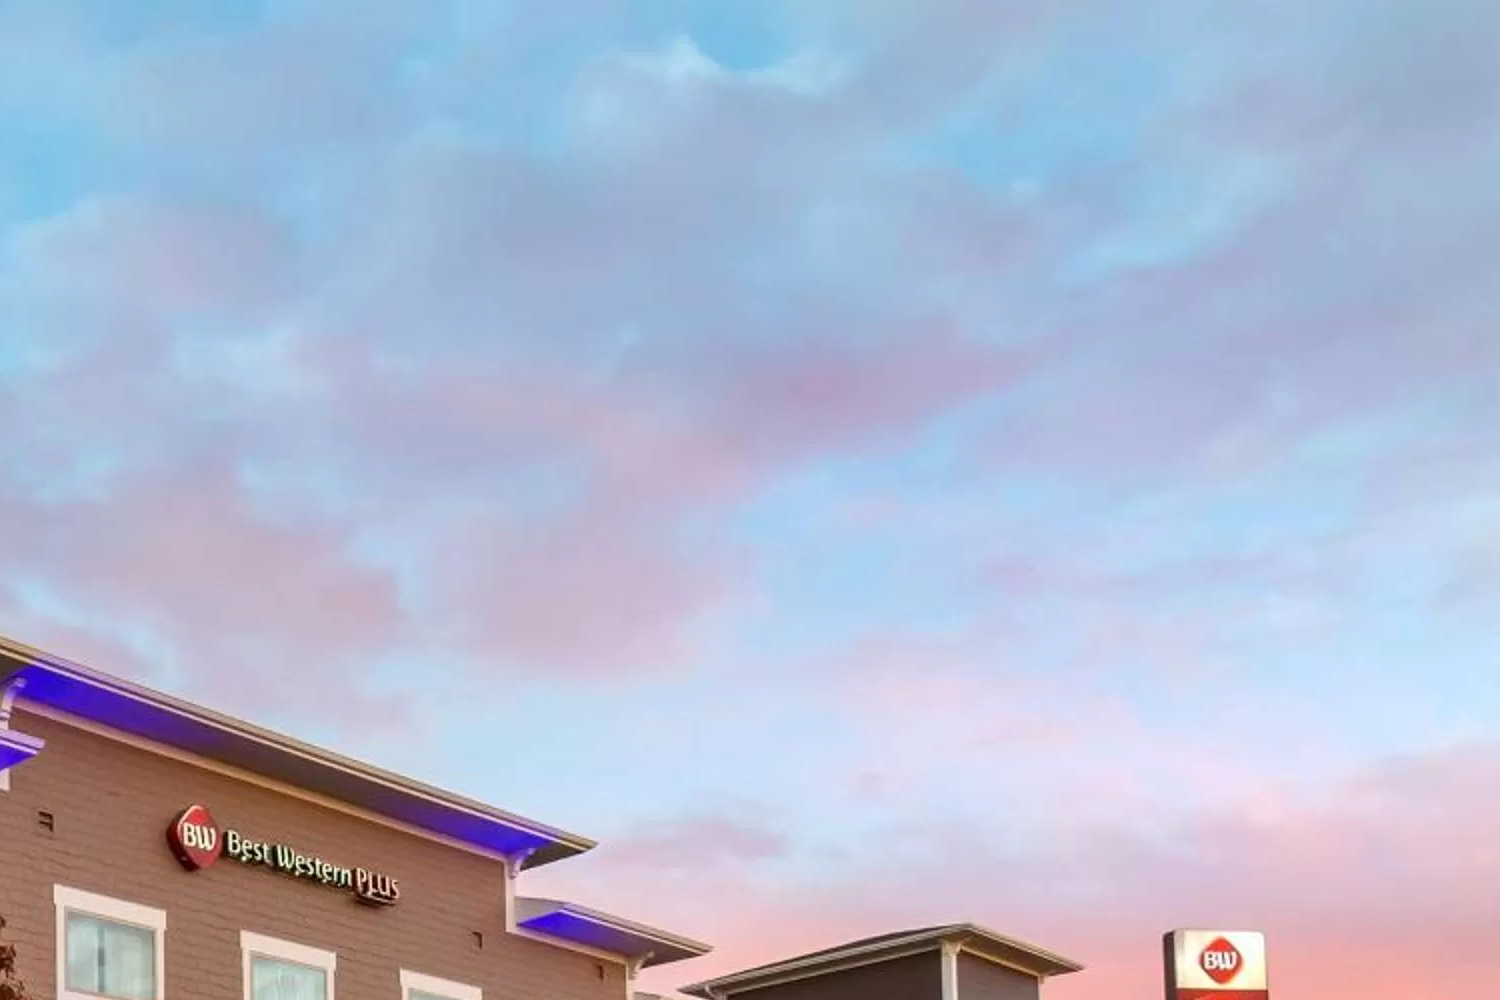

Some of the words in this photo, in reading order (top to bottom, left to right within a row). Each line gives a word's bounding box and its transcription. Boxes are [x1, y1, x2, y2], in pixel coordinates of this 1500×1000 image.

[183, 822, 216, 851] BW
[227, 829, 272, 865] Best
[276, 844, 352, 887] Western
[355, 867, 400, 900] PLUS
[1204, 951, 1237, 970] BW
